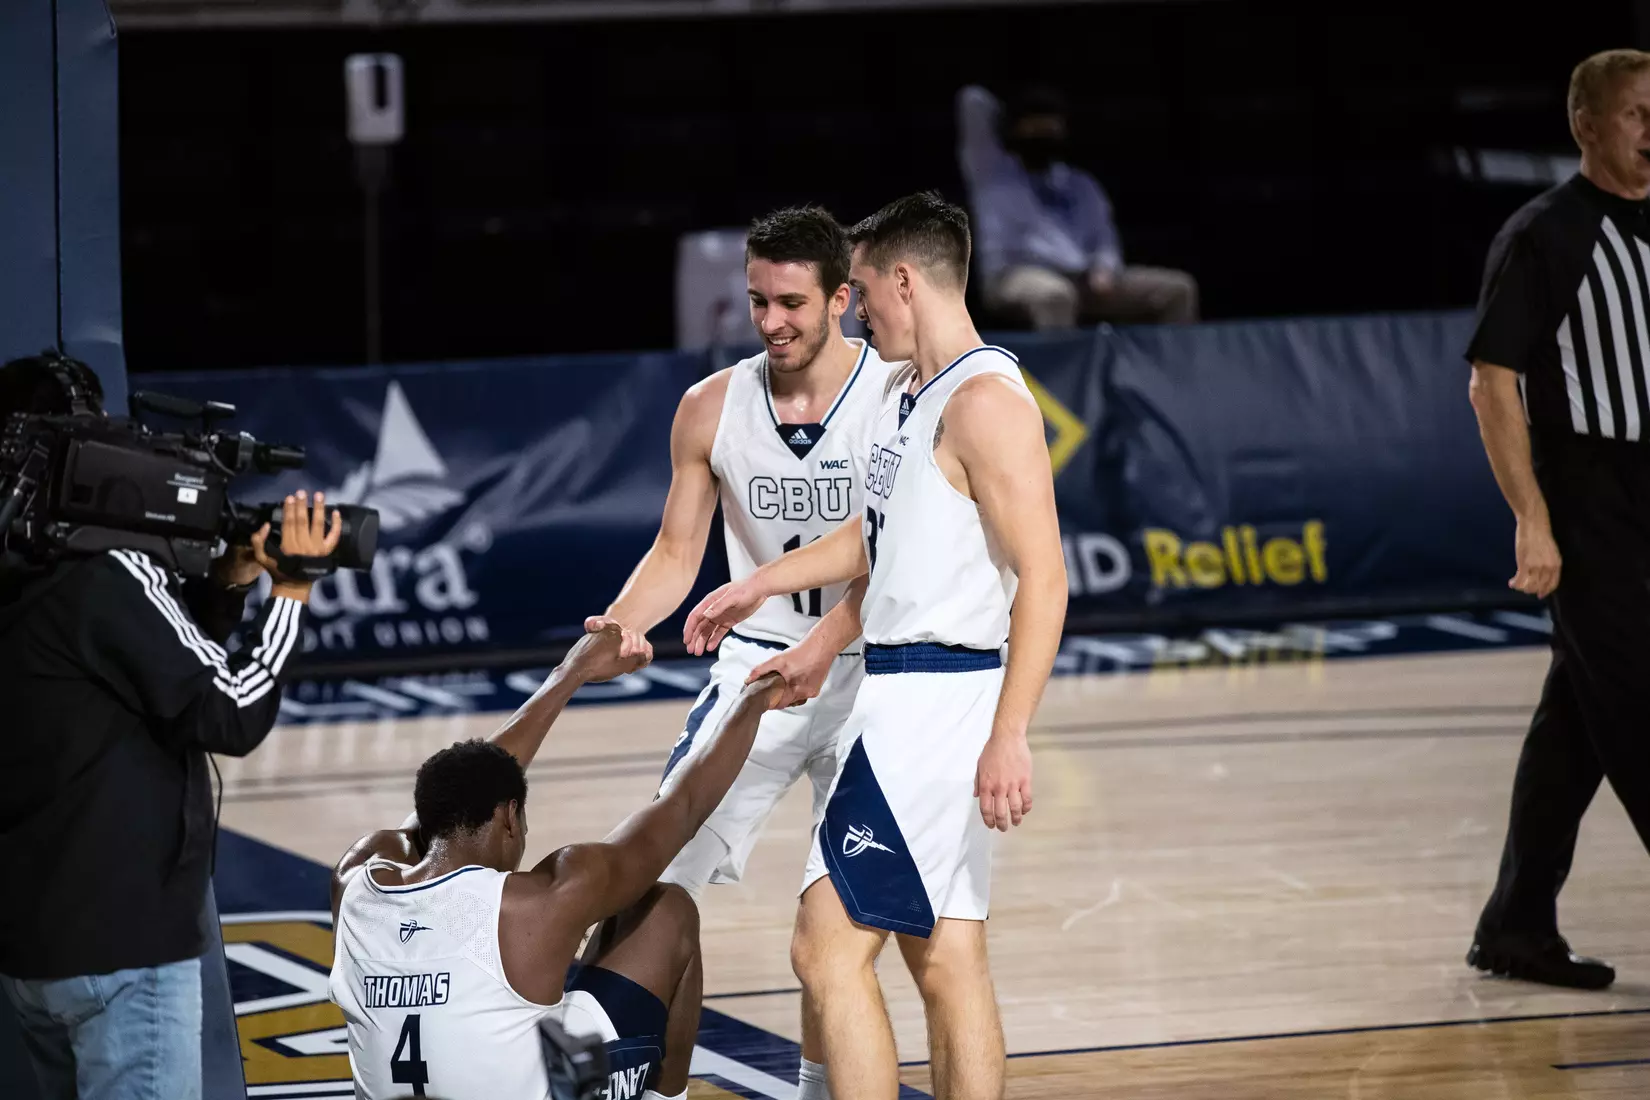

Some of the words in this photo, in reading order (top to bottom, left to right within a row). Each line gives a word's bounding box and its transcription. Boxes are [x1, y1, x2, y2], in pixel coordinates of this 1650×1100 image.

[820, 459, 849, 470] WAC
[865, 443, 902, 500] CBU
[749, 476, 852, 522] CBU
[1062, 532, 1132, 596] ID
[1143, 521, 1327, 588] Relief
[373, 616, 490, 648] UNION
[364, 972, 450, 1008] THOMAS
[390, 1014, 429, 1098] 4
